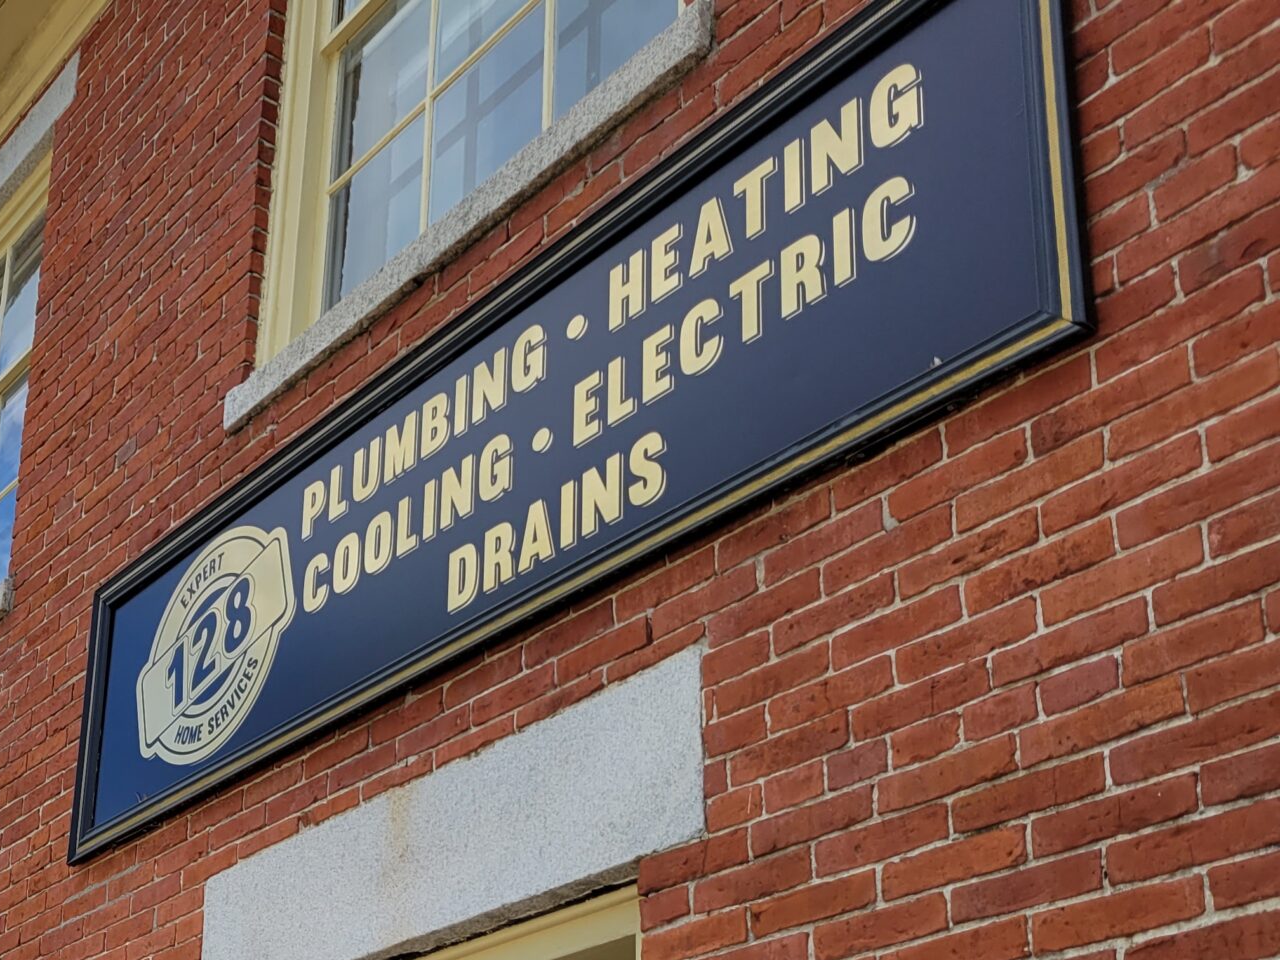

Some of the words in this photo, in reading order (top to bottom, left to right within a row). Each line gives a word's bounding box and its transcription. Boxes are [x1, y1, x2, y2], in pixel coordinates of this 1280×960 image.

[301, 323, 547, 540] PLUMBING
[609, 63, 924, 332] HEATING
[302, 433, 515, 614] COOLING
[573, 176, 916, 447] ELECTRIC
[181, 552, 225, 609] EXPERT
[447, 431, 668, 614] DRAINS
[166, 574, 254, 713] 128
[174, 724, 202, 745] HOME
[207, 656, 259, 735] SERVICES
